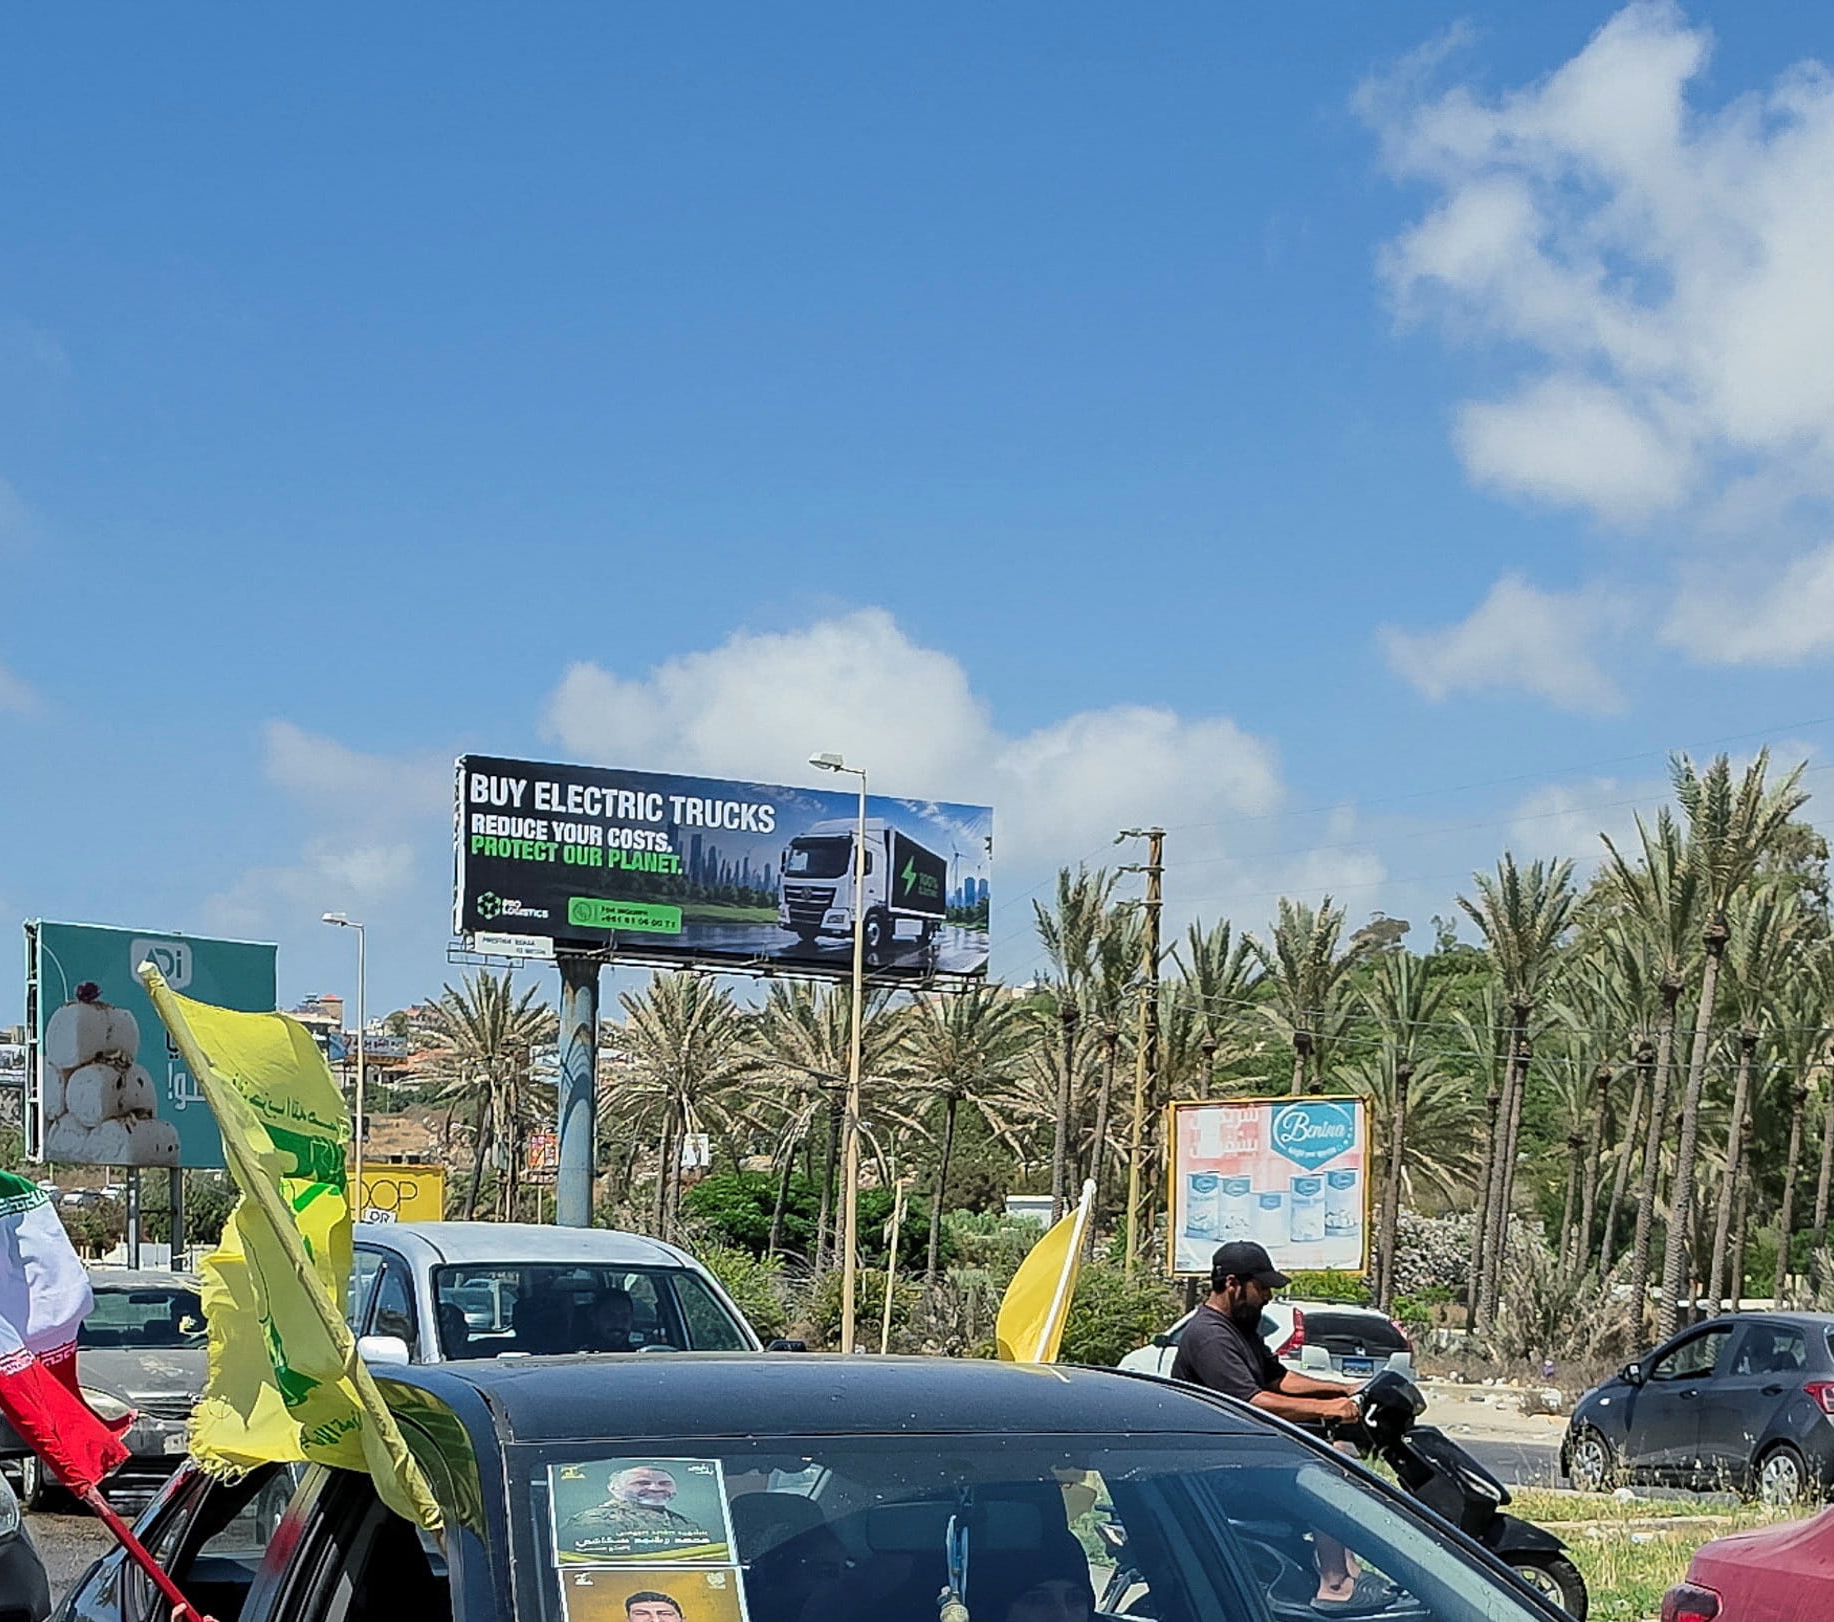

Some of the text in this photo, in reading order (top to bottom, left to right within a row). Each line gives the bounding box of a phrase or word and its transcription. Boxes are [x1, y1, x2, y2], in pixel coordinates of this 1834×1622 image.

[470, 774, 776, 833] BUY ELECTRIC TRUCKS
[471, 813, 673, 853] REDUCE YOUR COSTS.
[471, 835, 683, 875] PROTECT OUR PLANET.
